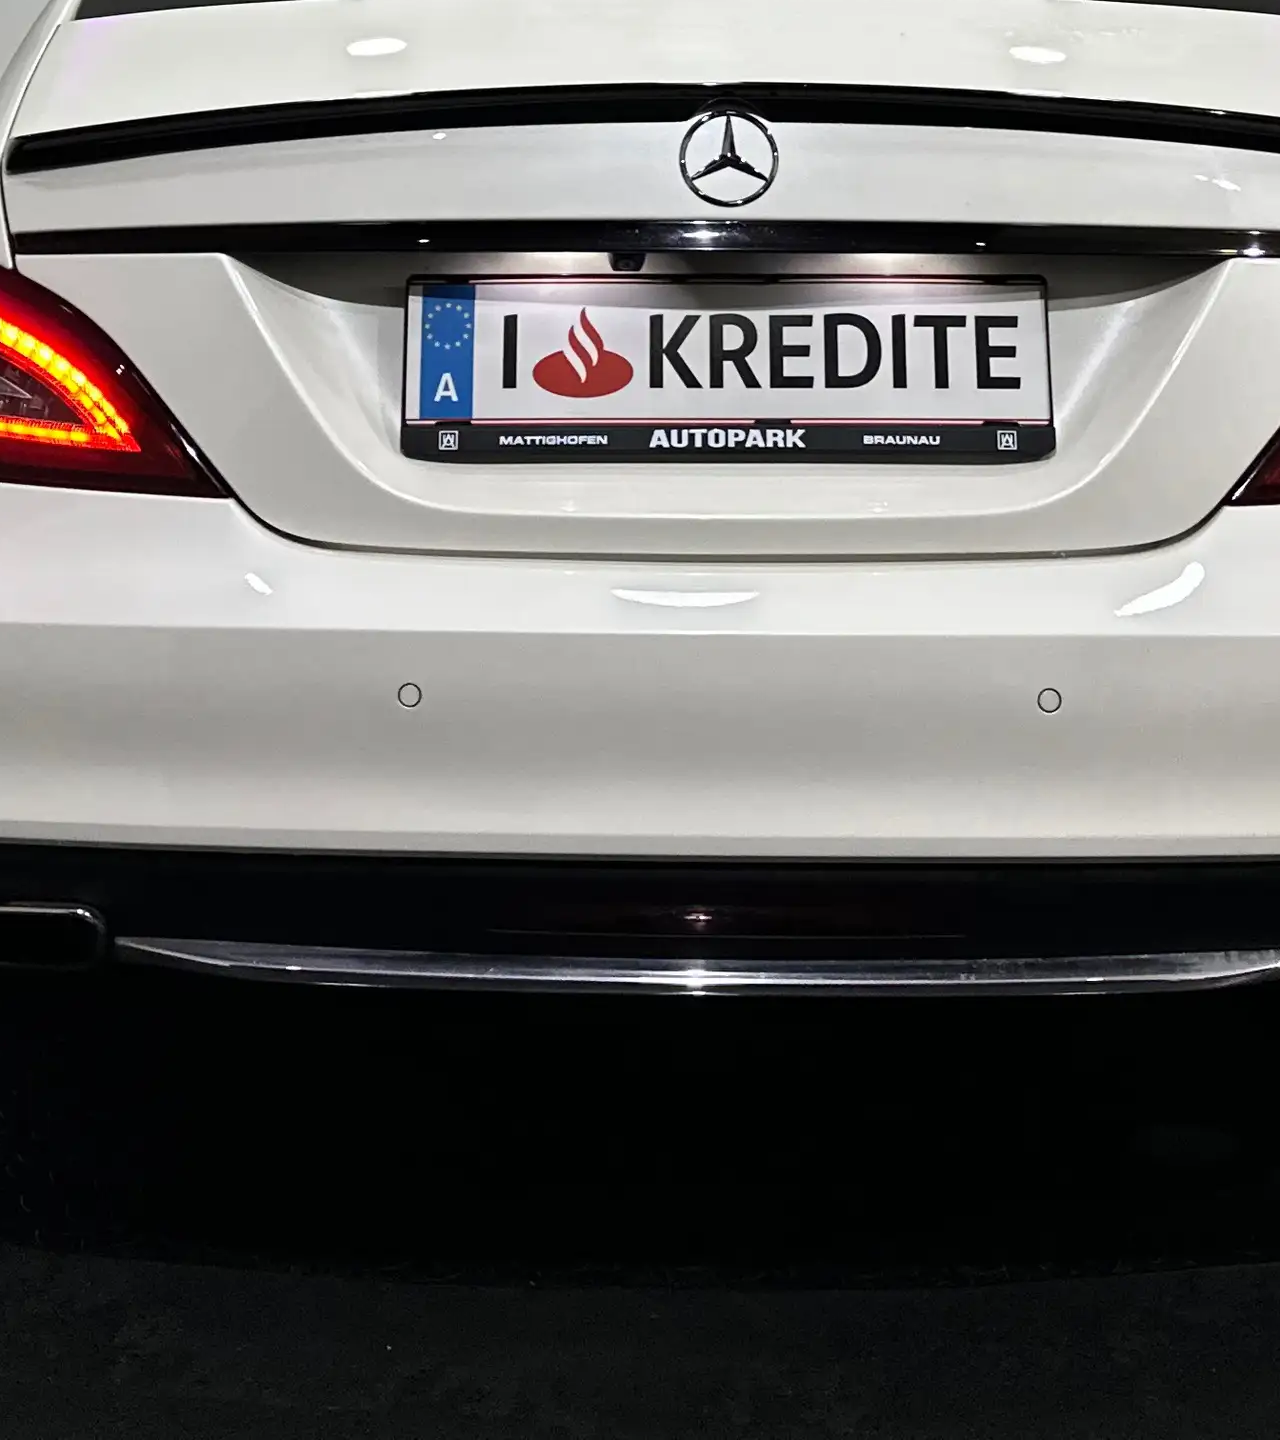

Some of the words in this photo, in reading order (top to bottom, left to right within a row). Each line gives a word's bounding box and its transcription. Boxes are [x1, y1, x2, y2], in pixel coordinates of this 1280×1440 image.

[502, 314, 518, 390] I
[648, 312, 1022, 390] KREDITE
[432, 371, 460, 402] A
[499, 434, 608, 446] MATTIGHOFEN
[649, 427, 806, 449] AUTOPARK
[863, 434, 941, 446] BRAUNAU
